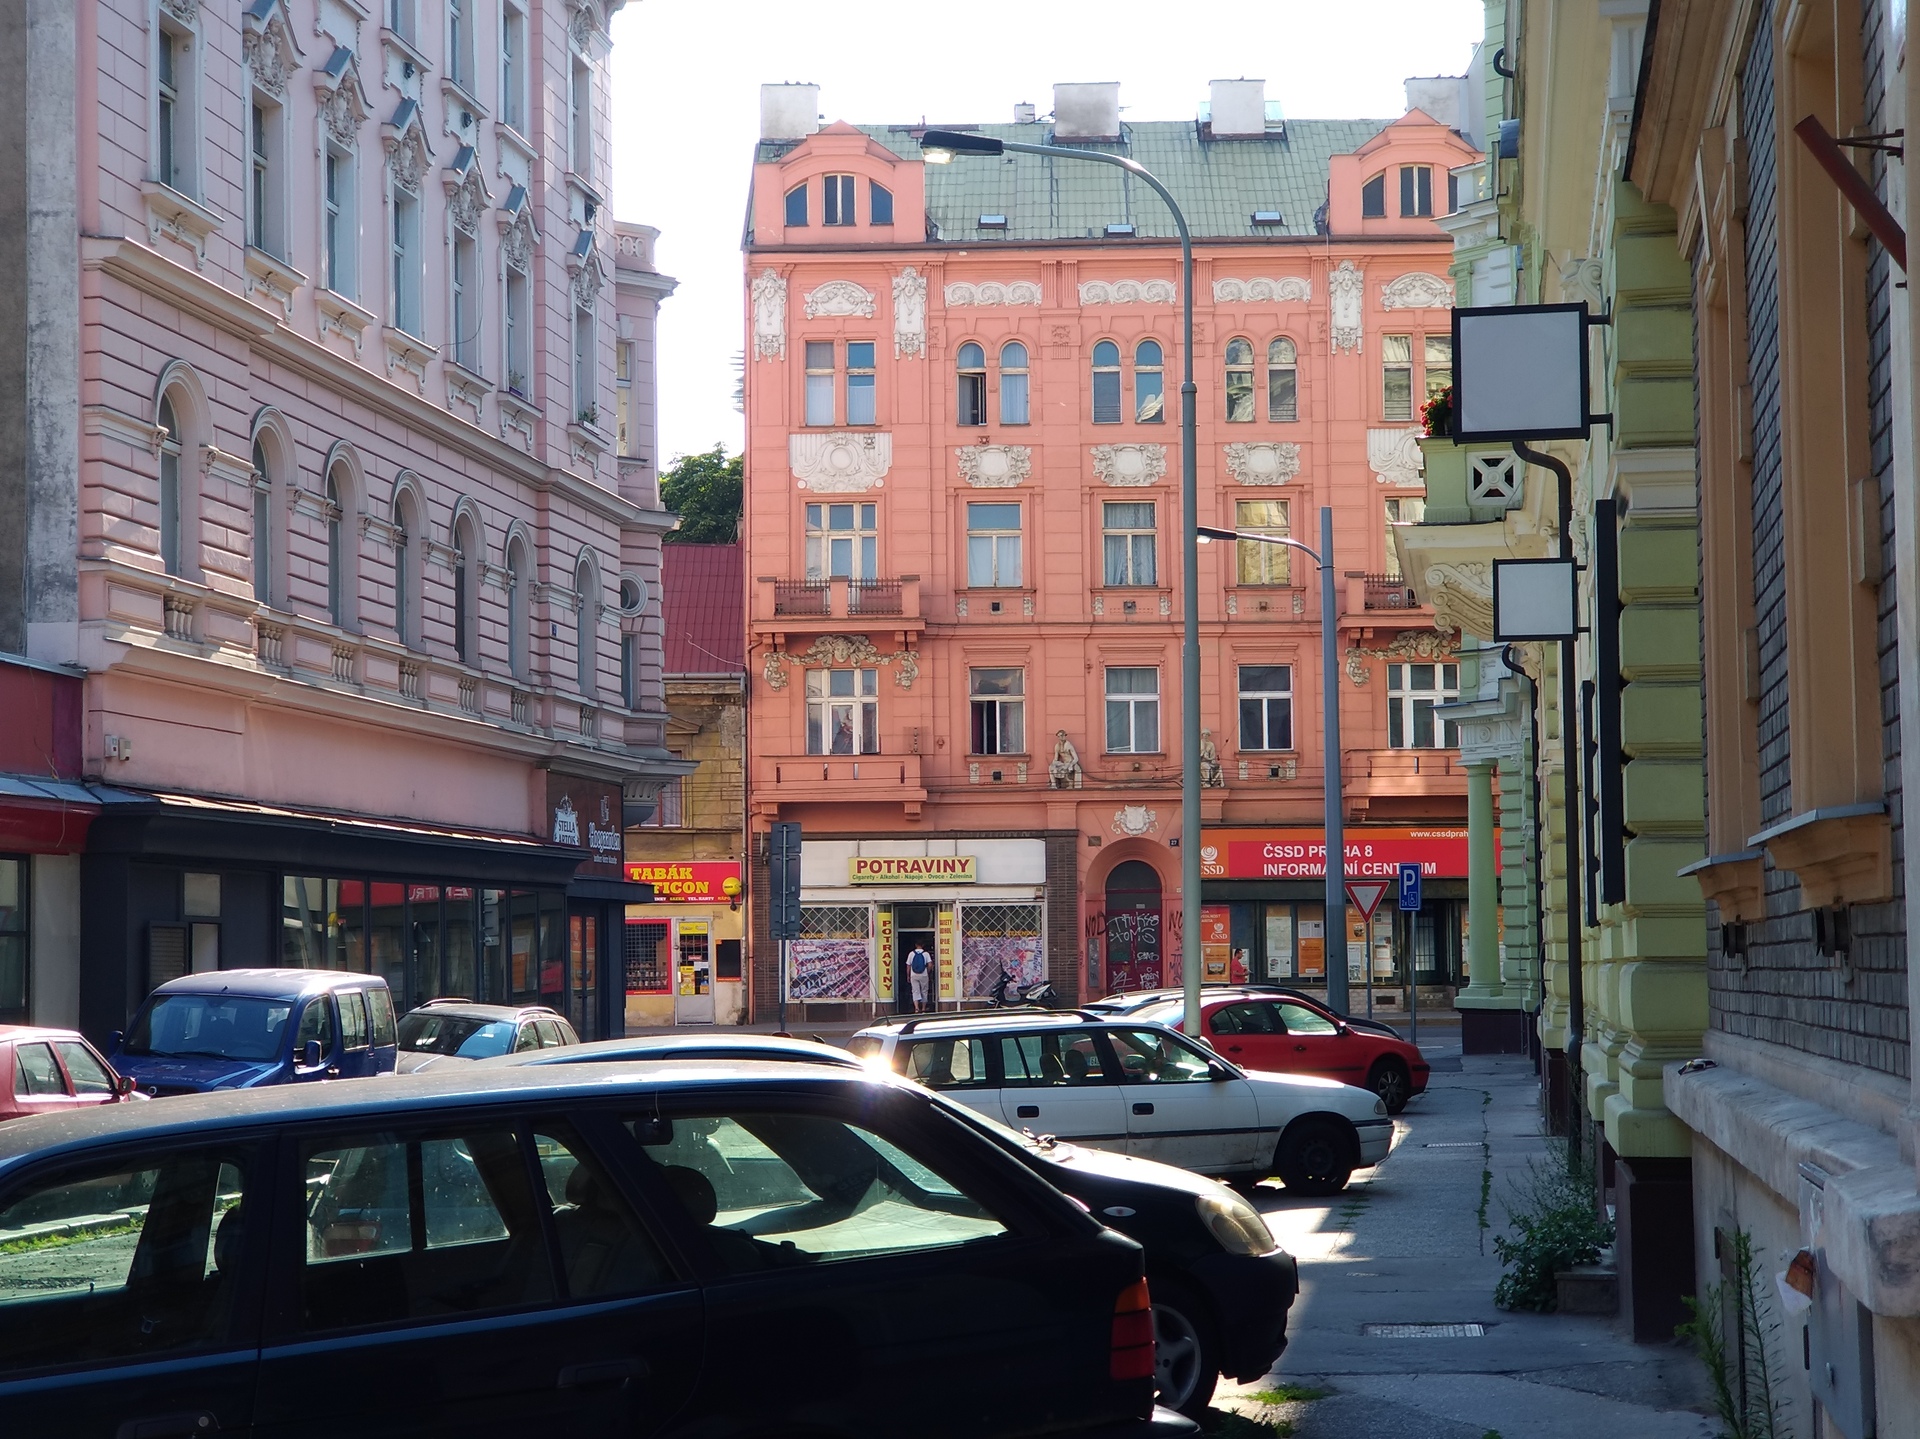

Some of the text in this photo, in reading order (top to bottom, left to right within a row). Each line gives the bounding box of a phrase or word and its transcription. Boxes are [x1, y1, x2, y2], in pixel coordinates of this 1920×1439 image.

[559, 820, 575, 833] STELLA
[1410, 830, 1468, 838] www.cssdprah
[1263, 843, 1373, 858] ČSSD PRHA 8
[630, 864, 693, 880] TABÁK
[857, 859, 970, 873] POTRAVINY
[1263, 860, 1436, 875] INFORMNÍ CENTM
[653, 881, 709, 894] FICON
[1403, 870, 1416, 896] P
[882, 920, 892, 991] POTRAVINY
